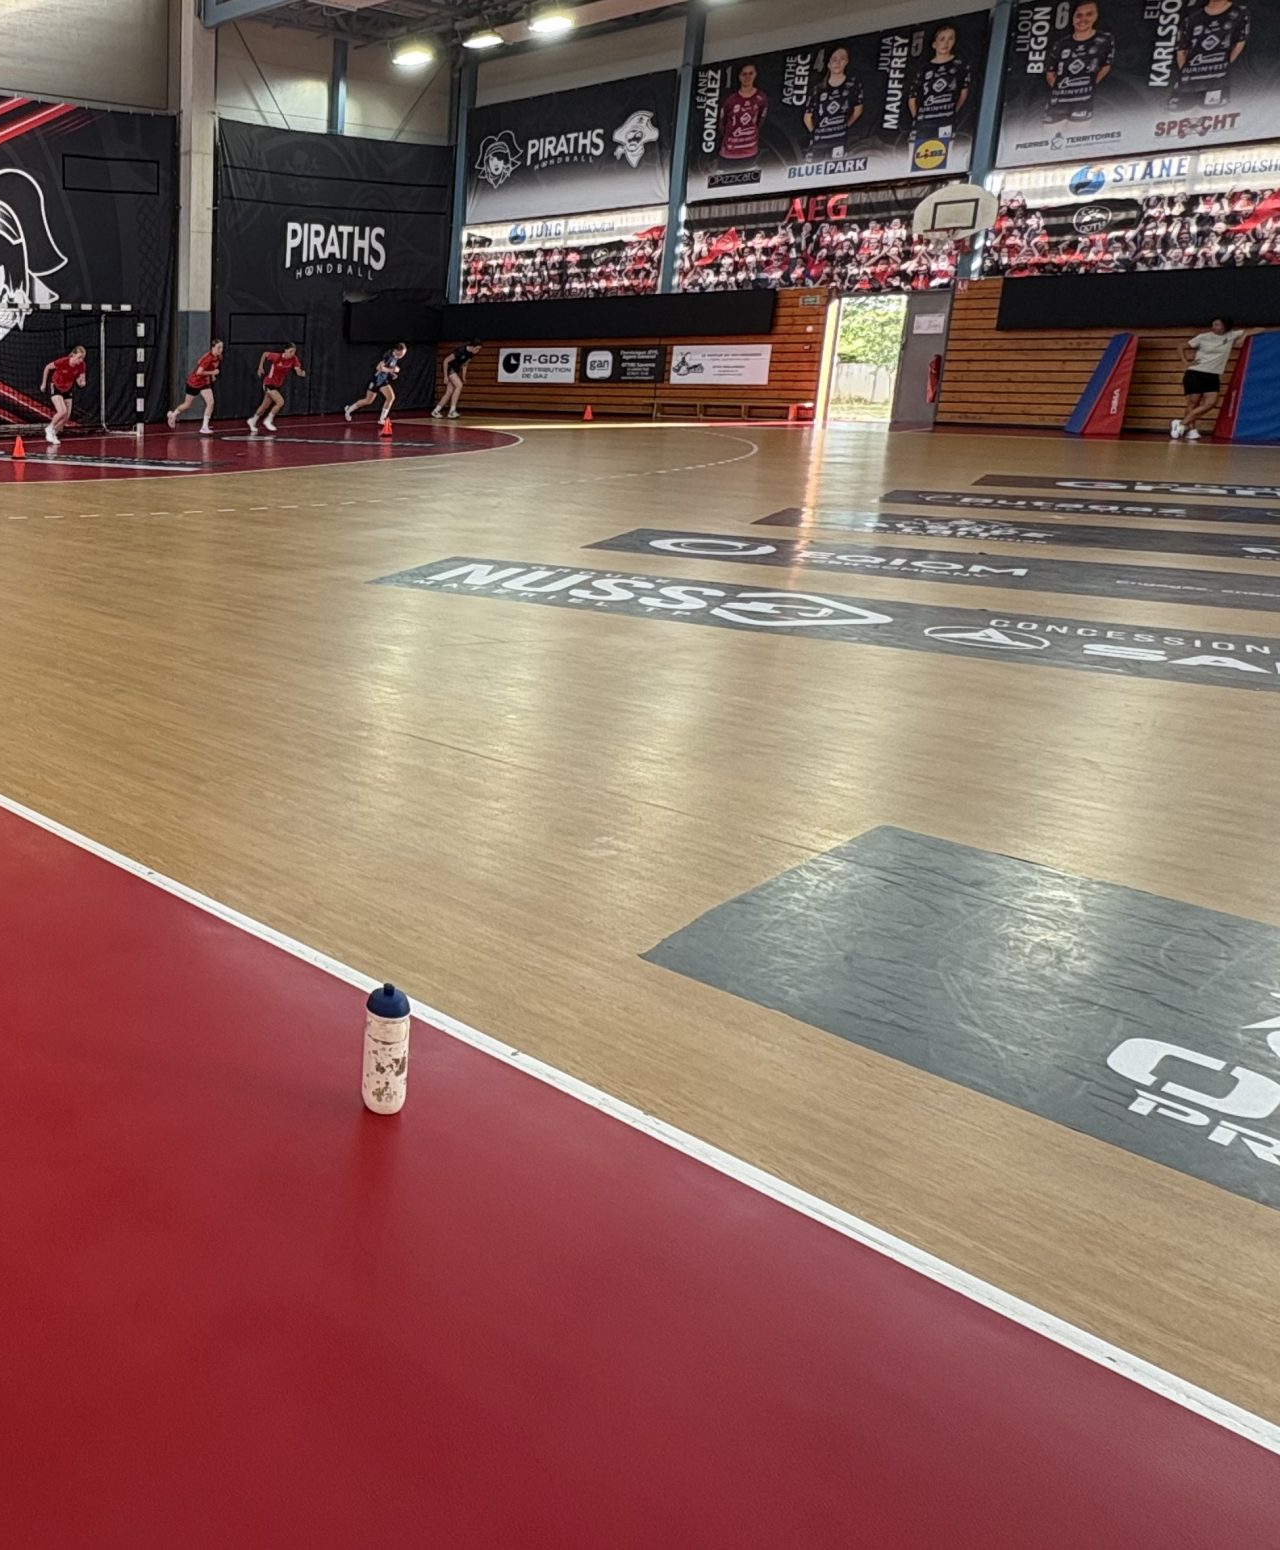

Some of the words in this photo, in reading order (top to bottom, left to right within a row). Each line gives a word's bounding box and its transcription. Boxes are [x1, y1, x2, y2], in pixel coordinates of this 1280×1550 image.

[1016, 9, 1033, 52] LILOU
[1027, 6, 1052, 74] BEGON
[878, 36, 893, 73] JULIA
[782, 55, 798, 106] AGATHE
[793, 53, 811, 106] CLERC
[883, 35, 910, 130] MAUFFREY
[702, 69, 721, 153] GONZALEZ
[526, 128, 605, 167] PIRATHS
[1112, 157, 1188, 183] STANE
[1204, 158, 1280, 177] GEISPOLSH
[285, 222, 386, 271] PIRATHS
[295, 263, 373, 281] HANDBALL
[523, 354, 570, 365] R-GDS
[589, 360, 609, 371] gan
[798, 549, 1030, 578] EQIOM
[427, 563, 726, 610] NUSS
[989, 618, 1272, 655] CONCESSION
[1082, 643, 1280, 676] SA
